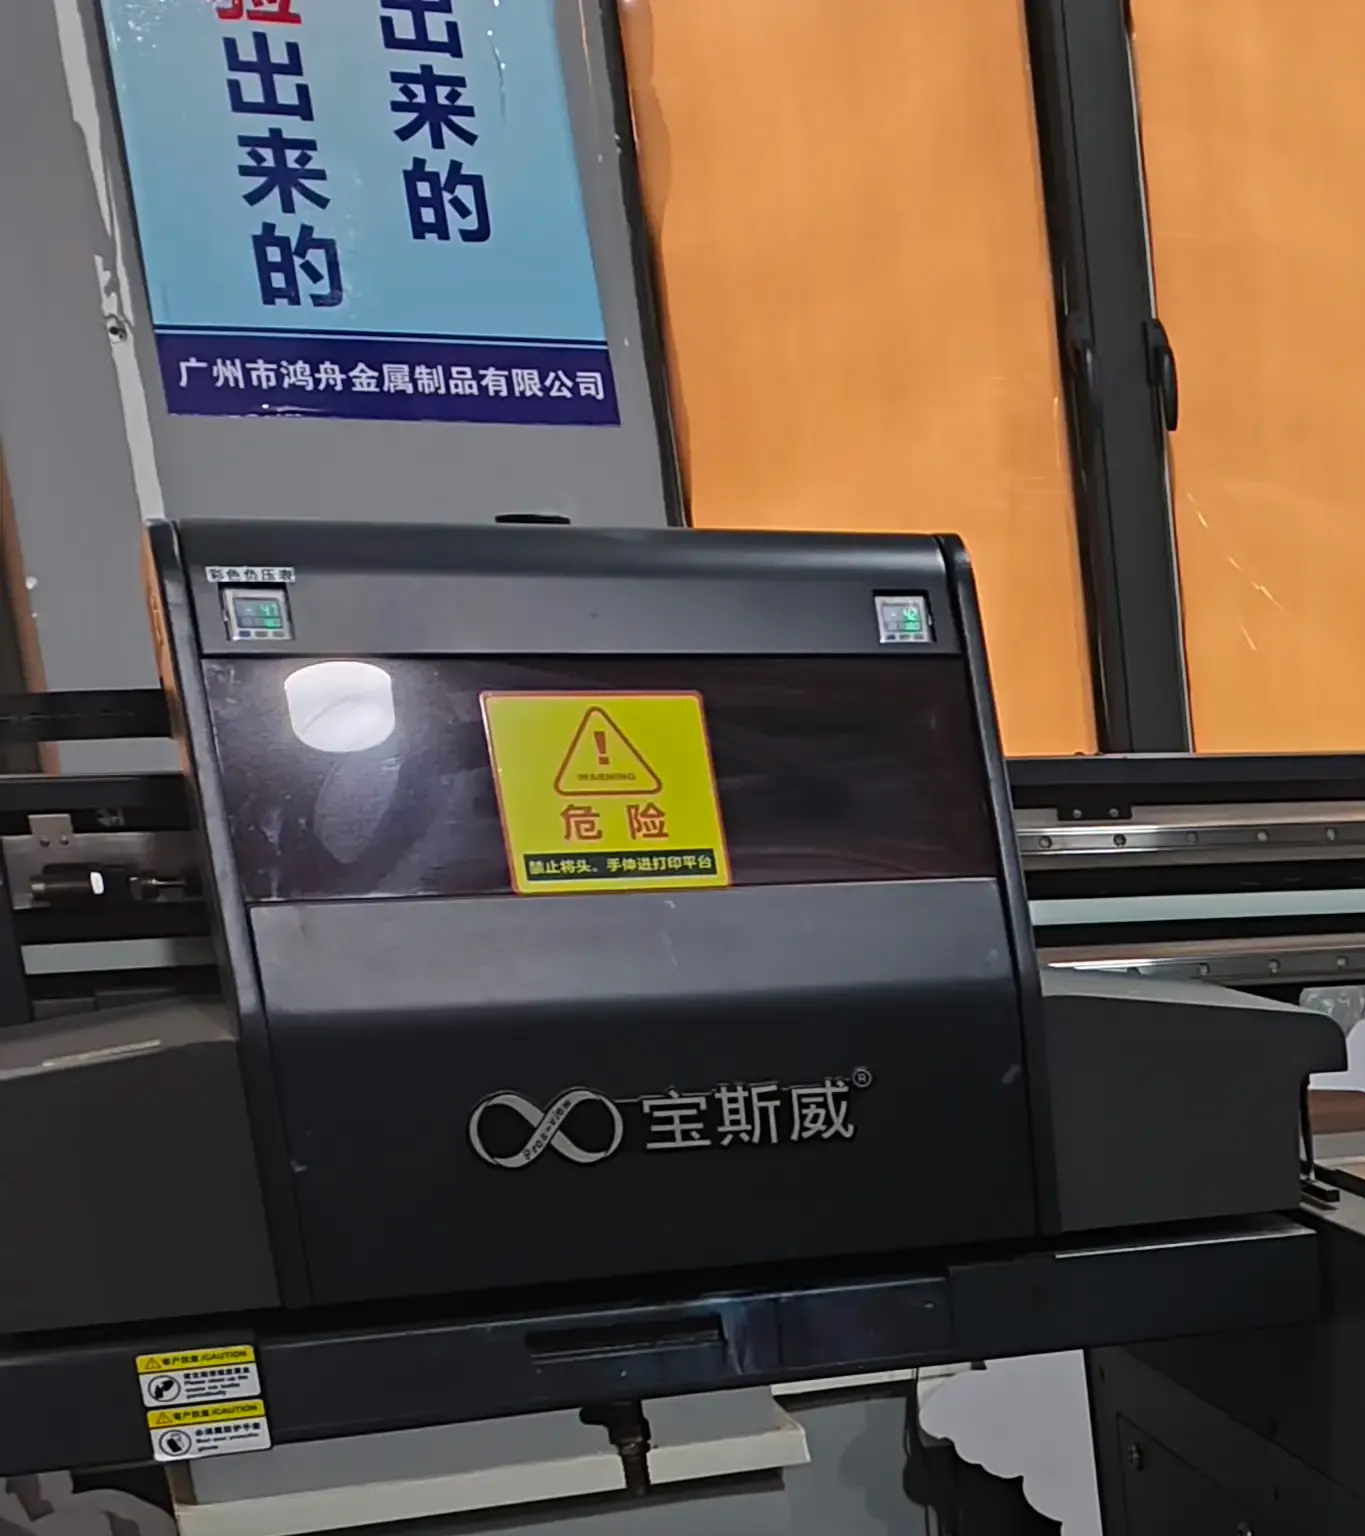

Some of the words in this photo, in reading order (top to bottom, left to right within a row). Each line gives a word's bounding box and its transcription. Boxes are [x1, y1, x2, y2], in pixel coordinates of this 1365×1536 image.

[215, 0, 345, 309] 出来的
[379, 0, 492, 244] 出来的
[177, 356, 606, 401] 广州市鸿舟金属制品有限公司
[560, 802, 669, 840] 危险
[642, 1078, 854, 1151] 宝斯威
